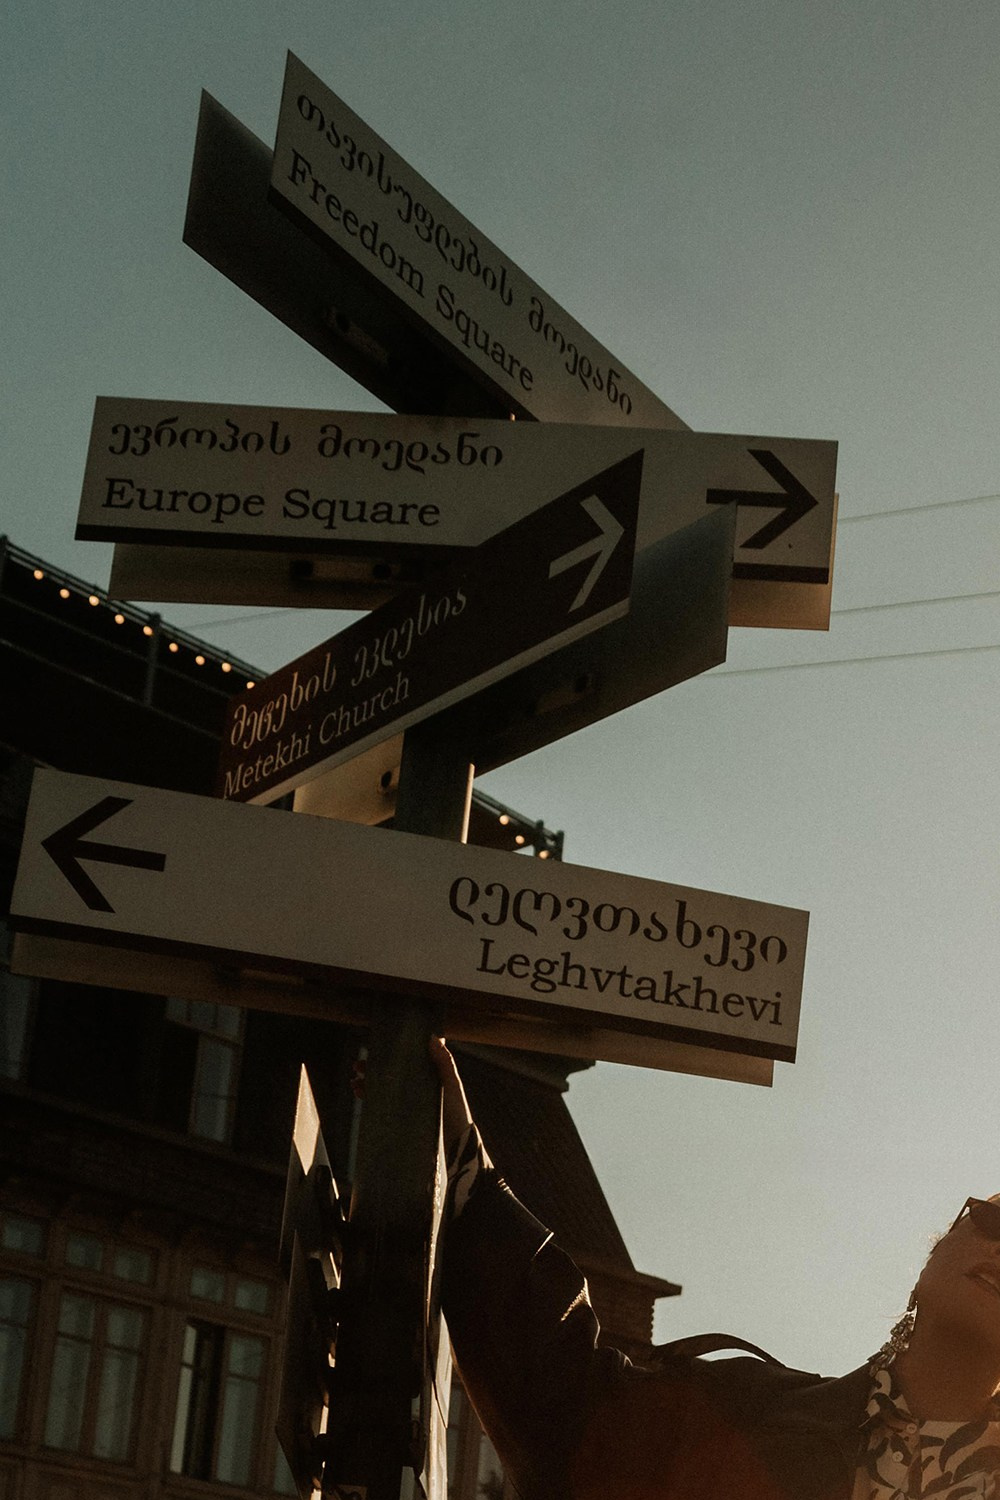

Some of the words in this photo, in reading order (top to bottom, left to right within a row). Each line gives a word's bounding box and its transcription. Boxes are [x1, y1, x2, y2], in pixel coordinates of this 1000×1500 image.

[287, 148, 424, 298] Freedom
[436, 284, 533, 391] Square
[297, 95, 513, 306] თავისუფლების
[528, 297, 632, 415] მოედანი
[109, 416, 291, 456] ევროპის
[318, 424, 503, 474] მოედანი
[102, 478, 265, 523] Europe
[282, 488, 440, 529] Square
[230, 652, 337, 750] მეტეხის
[351, 587, 467, 687] ეკლესია
[223, 724, 312, 800] Metekhi
[319, 671, 409, 745] Church
[449, 877, 788, 972] ლეღვთახევი
[477, 938, 782, 1026] Leghvtakhevi
